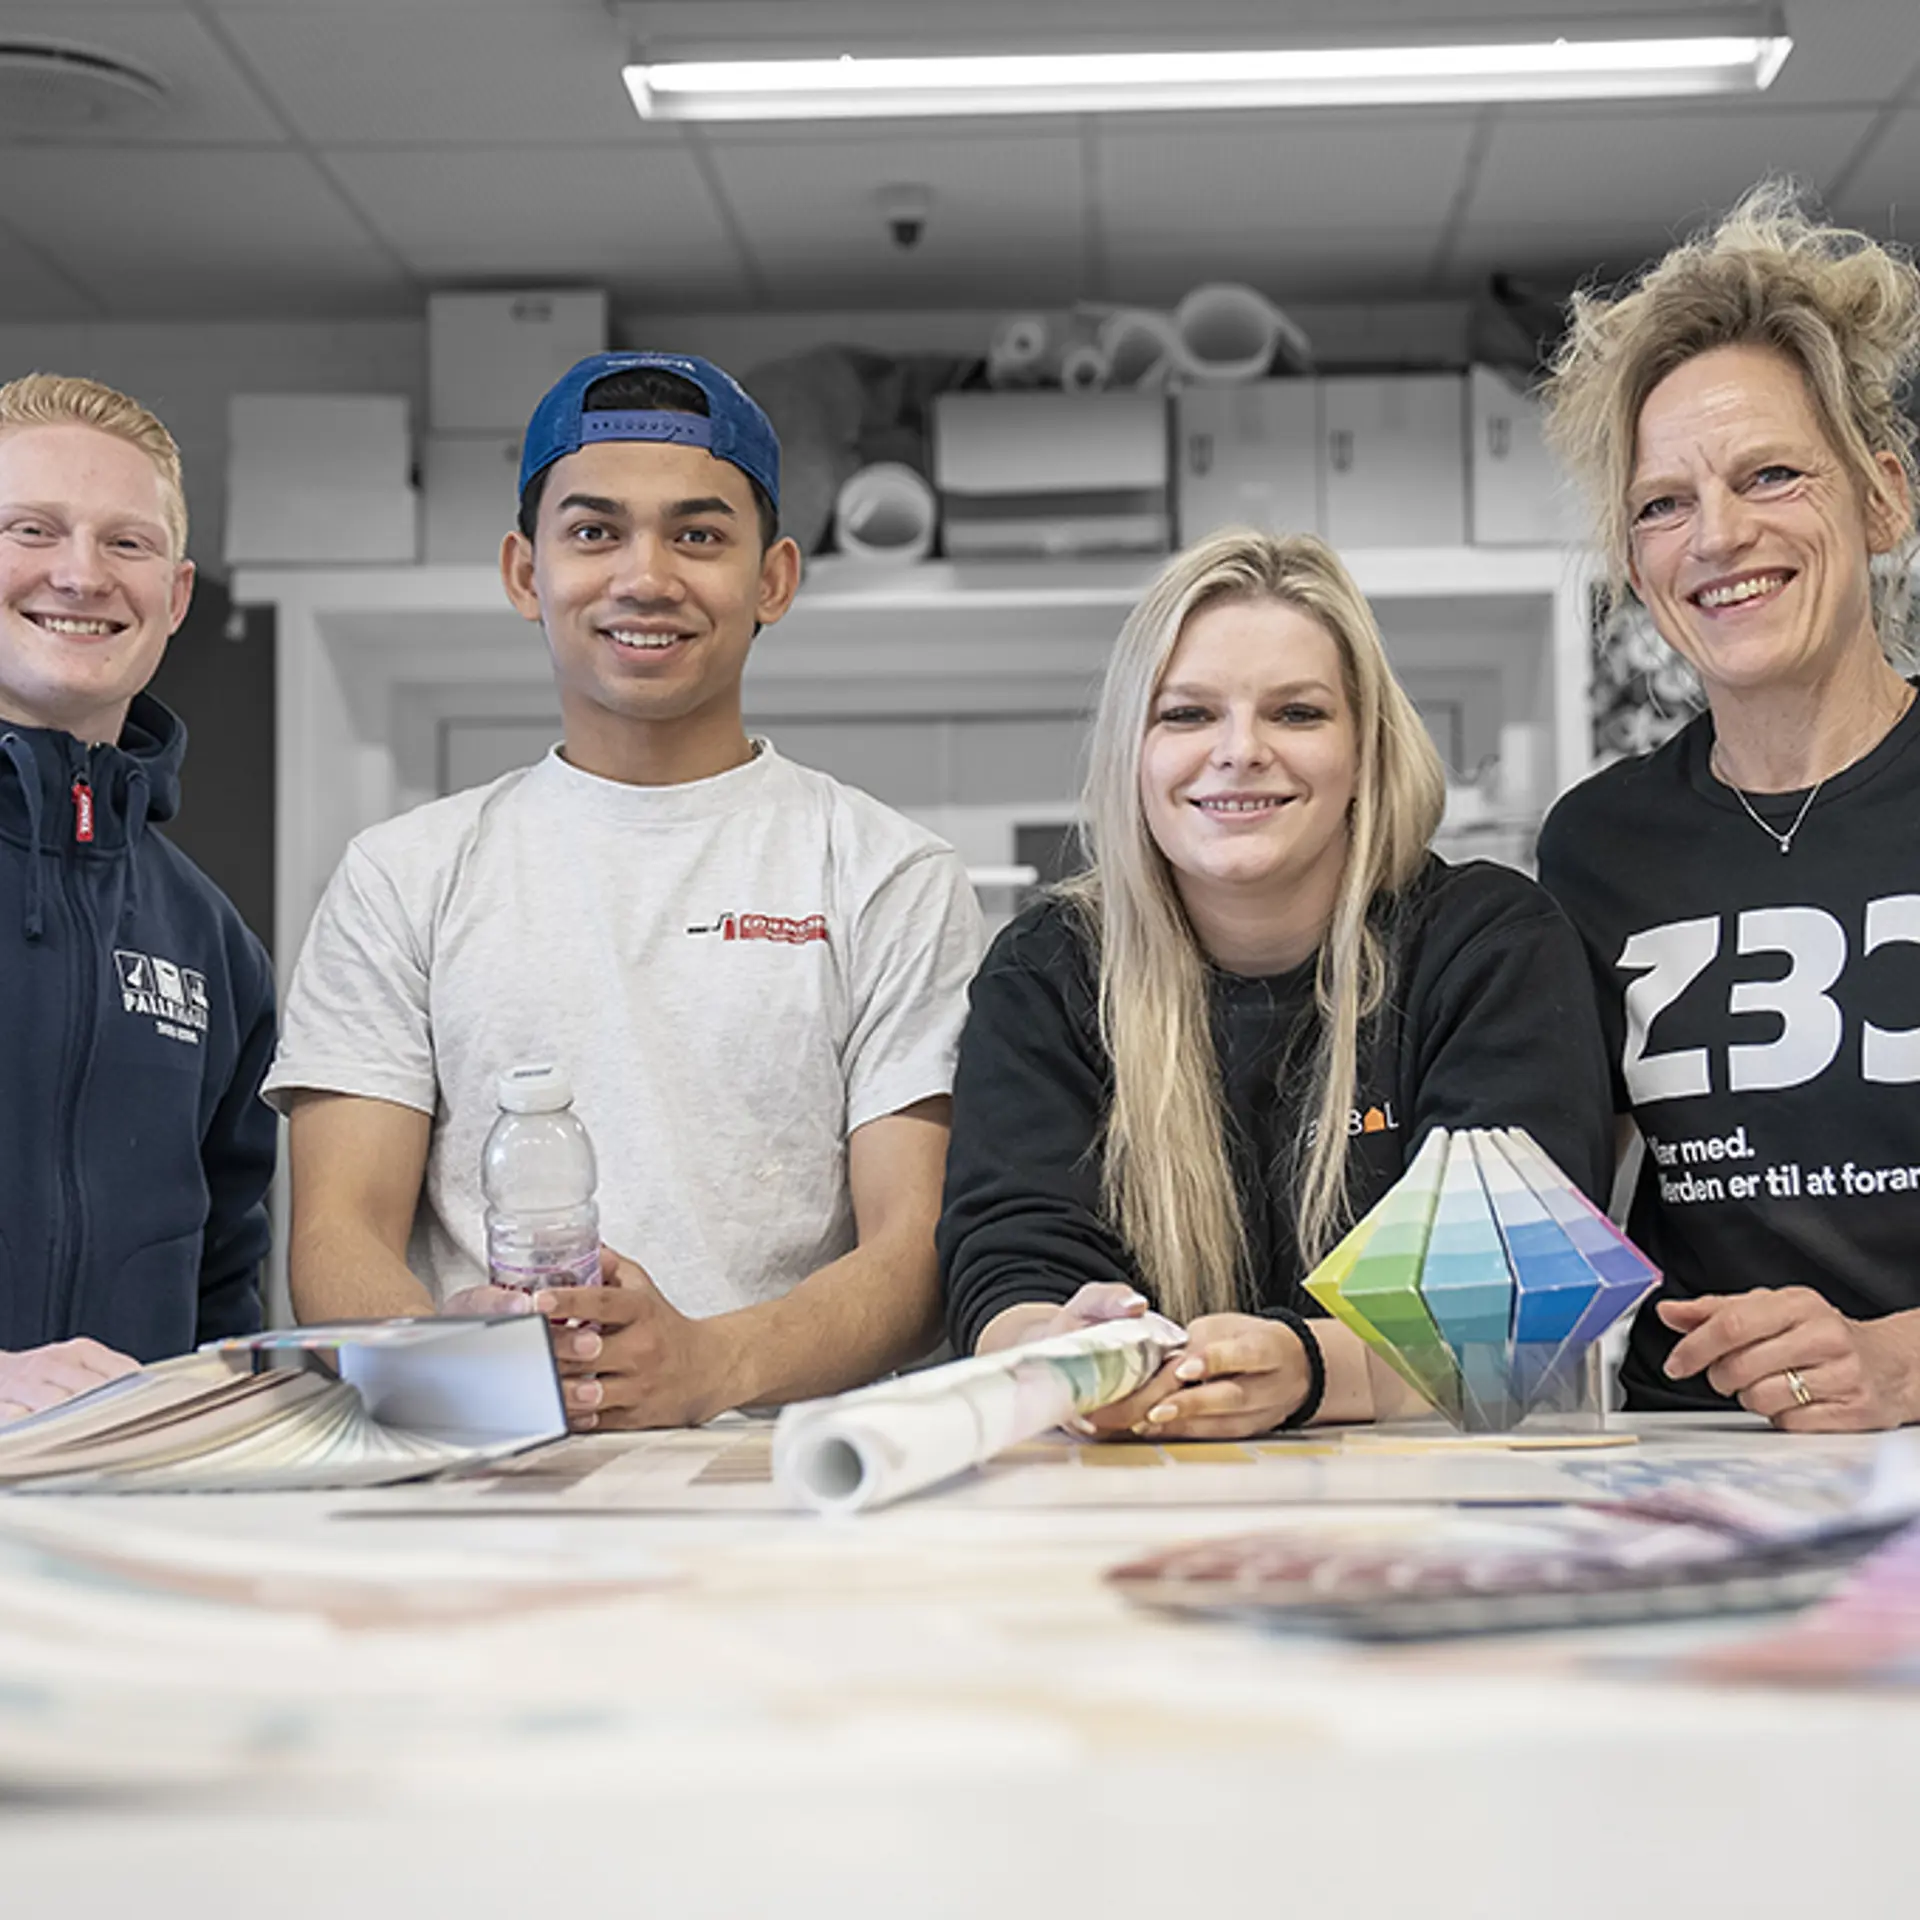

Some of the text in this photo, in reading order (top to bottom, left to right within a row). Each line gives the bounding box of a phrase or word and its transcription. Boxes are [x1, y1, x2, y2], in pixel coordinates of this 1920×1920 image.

[1681, 1126, 1756, 1163] med.
[1728, 1173, 1760, 1199] er
[1765, 1163, 1800, 1197] til
[1806, 1165, 1838, 1196] at
